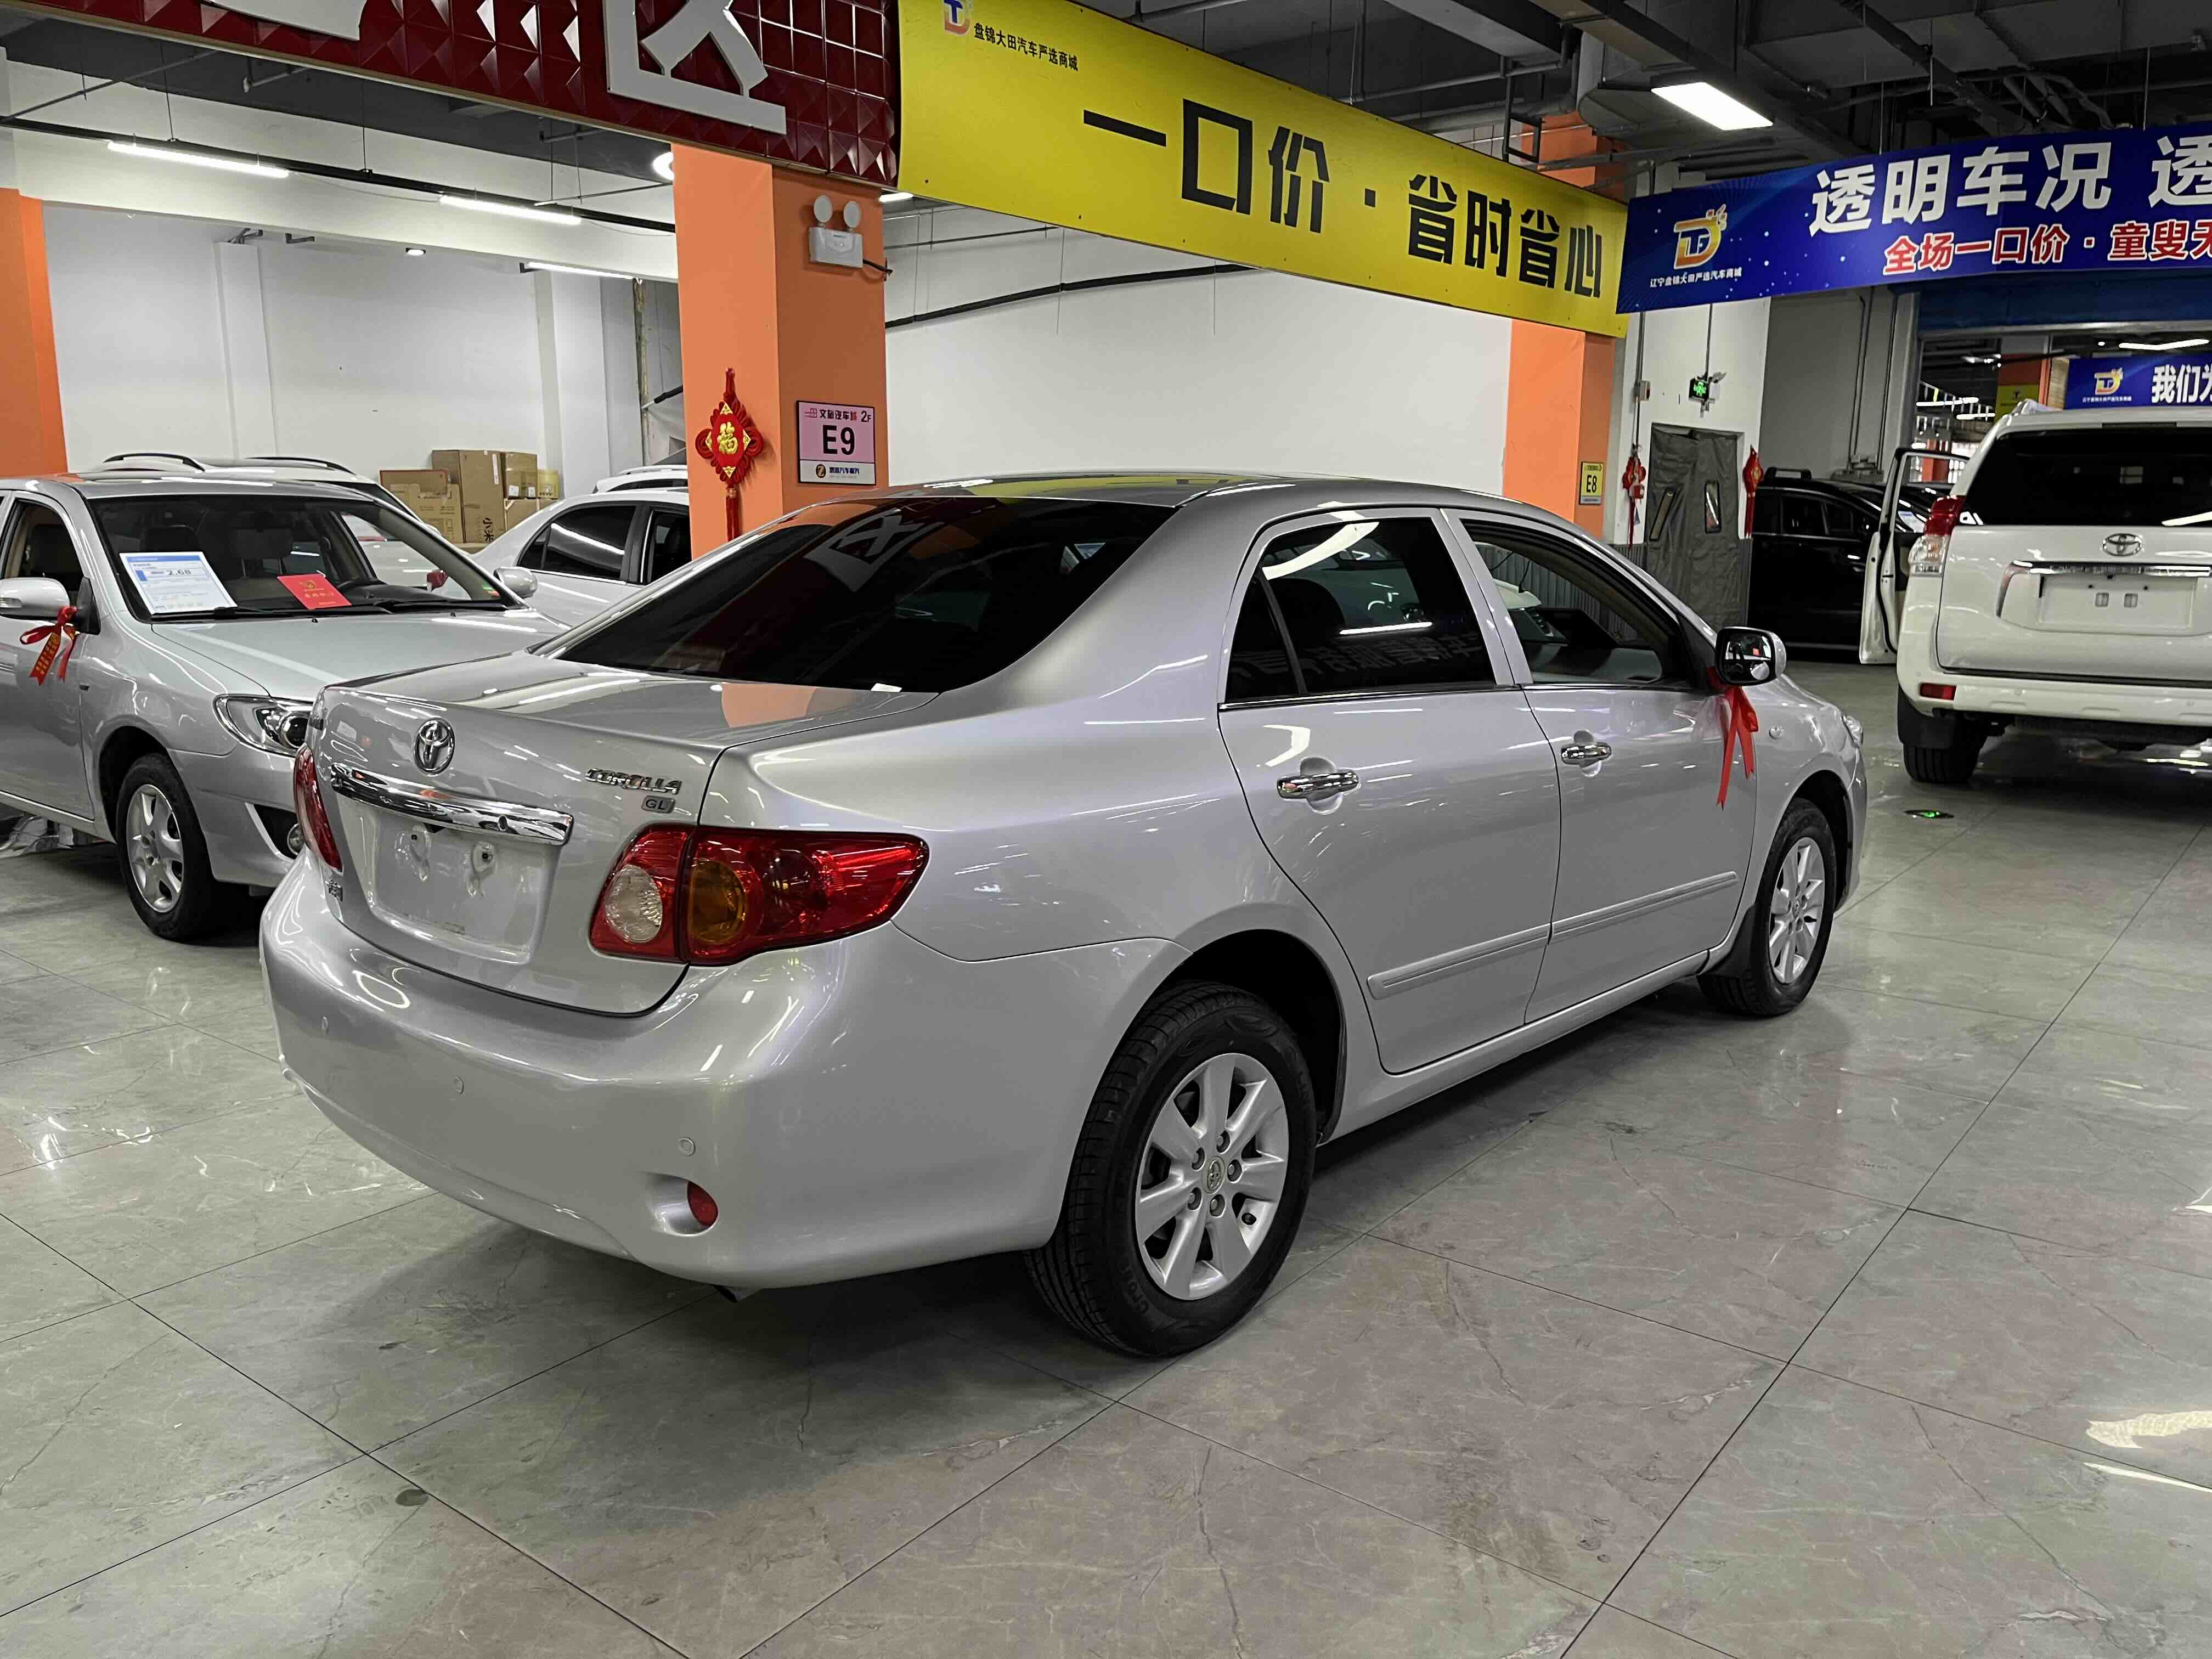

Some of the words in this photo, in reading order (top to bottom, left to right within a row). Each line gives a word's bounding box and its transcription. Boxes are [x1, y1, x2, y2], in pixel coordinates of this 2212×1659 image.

[974, 22, 1079, 71] 盘锦大田汽车严选商城
[1809, 142, 2112, 238] 透明车况
[861, 410, 872, 422] 2F
[822, 424, 855, 455] E9
[1586, 475, 1598, 493] E8
[483, 517, 495, 541] 小米
[645, 798, 665, 810] GL
